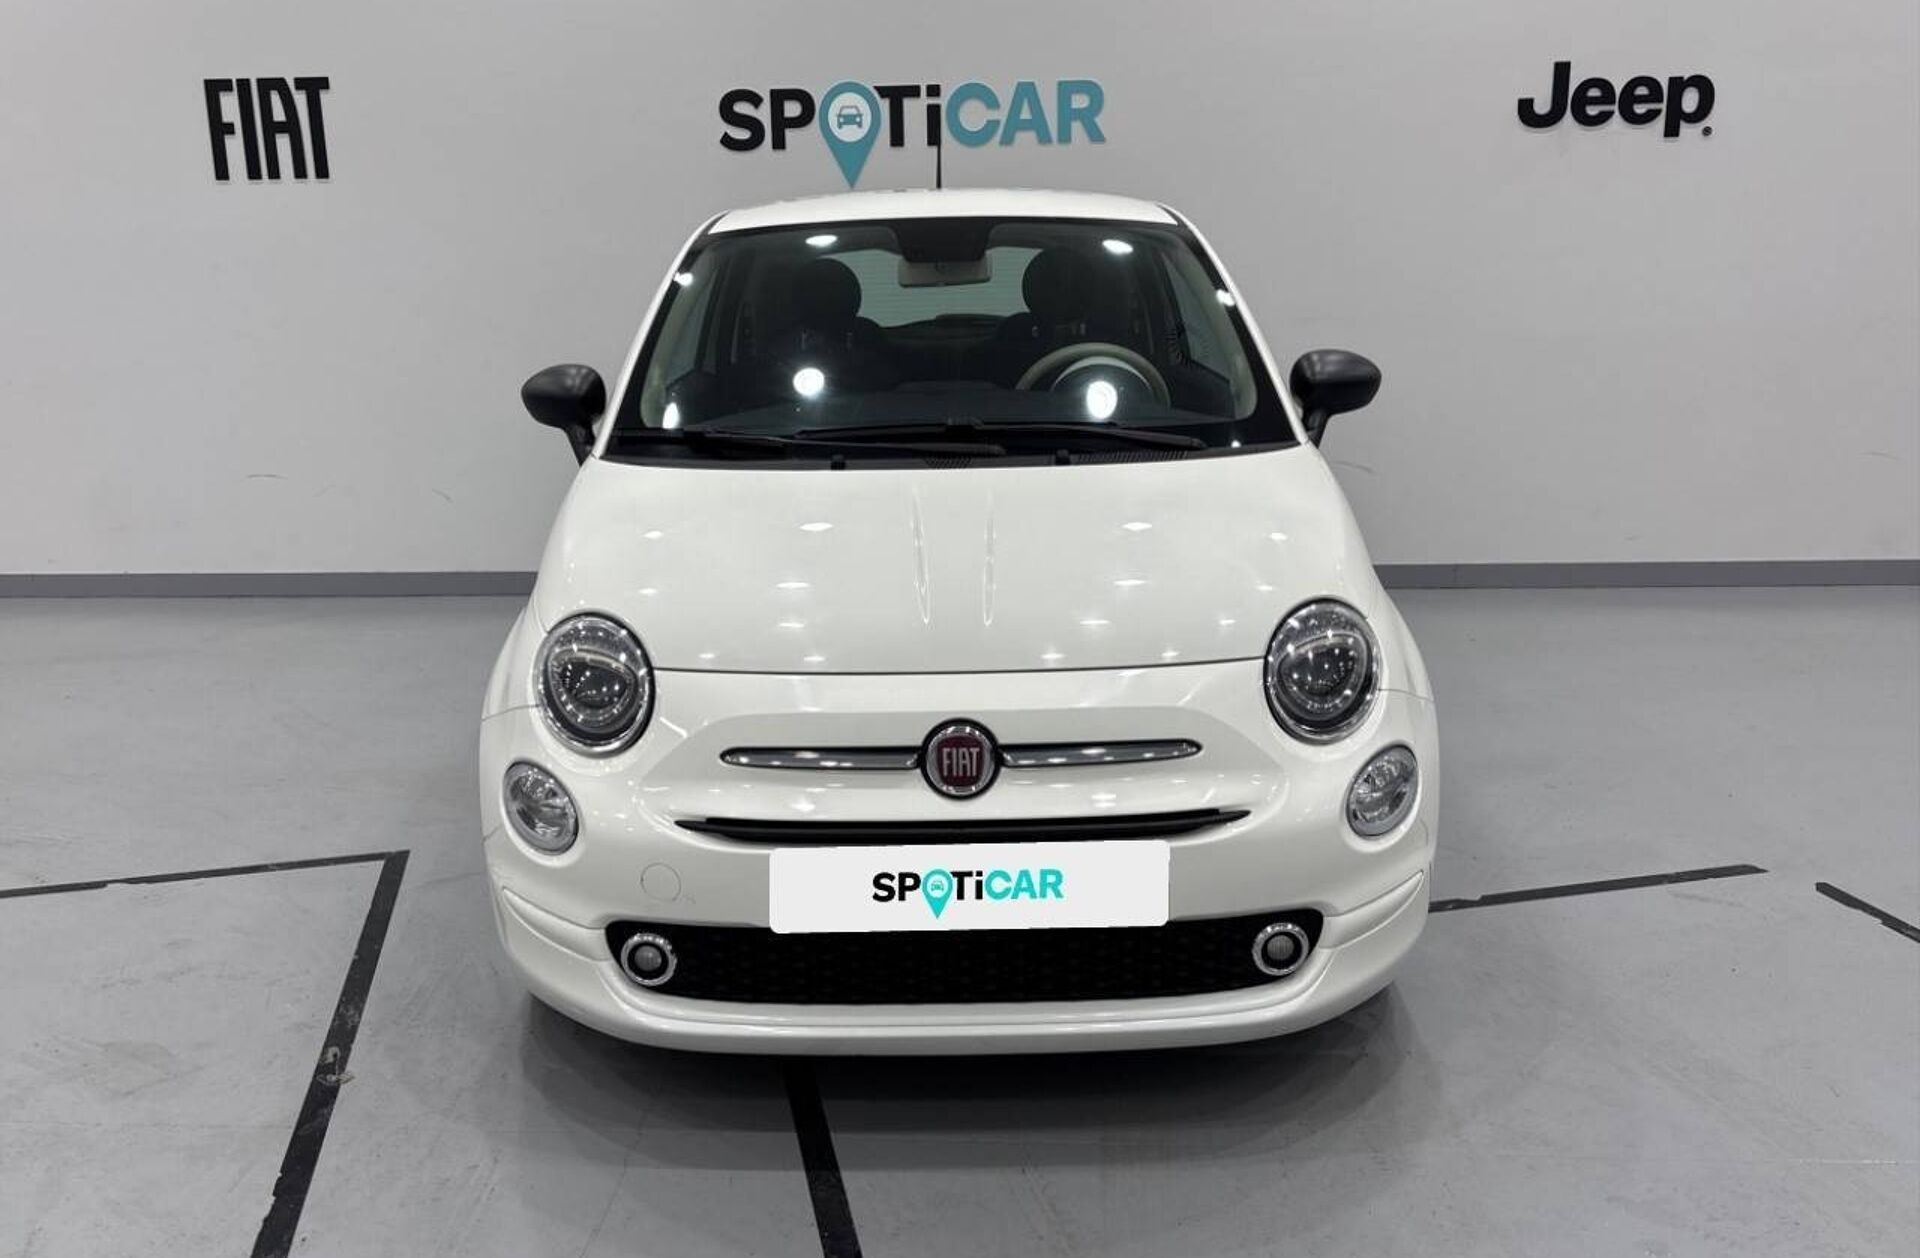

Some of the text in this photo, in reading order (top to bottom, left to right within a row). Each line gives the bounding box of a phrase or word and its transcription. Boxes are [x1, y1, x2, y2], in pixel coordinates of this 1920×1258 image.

[204, 76, 330, 181] FIAT
[1517, 61, 1715, 137] Jeep
[942, 746, 980, 777] FIAT
